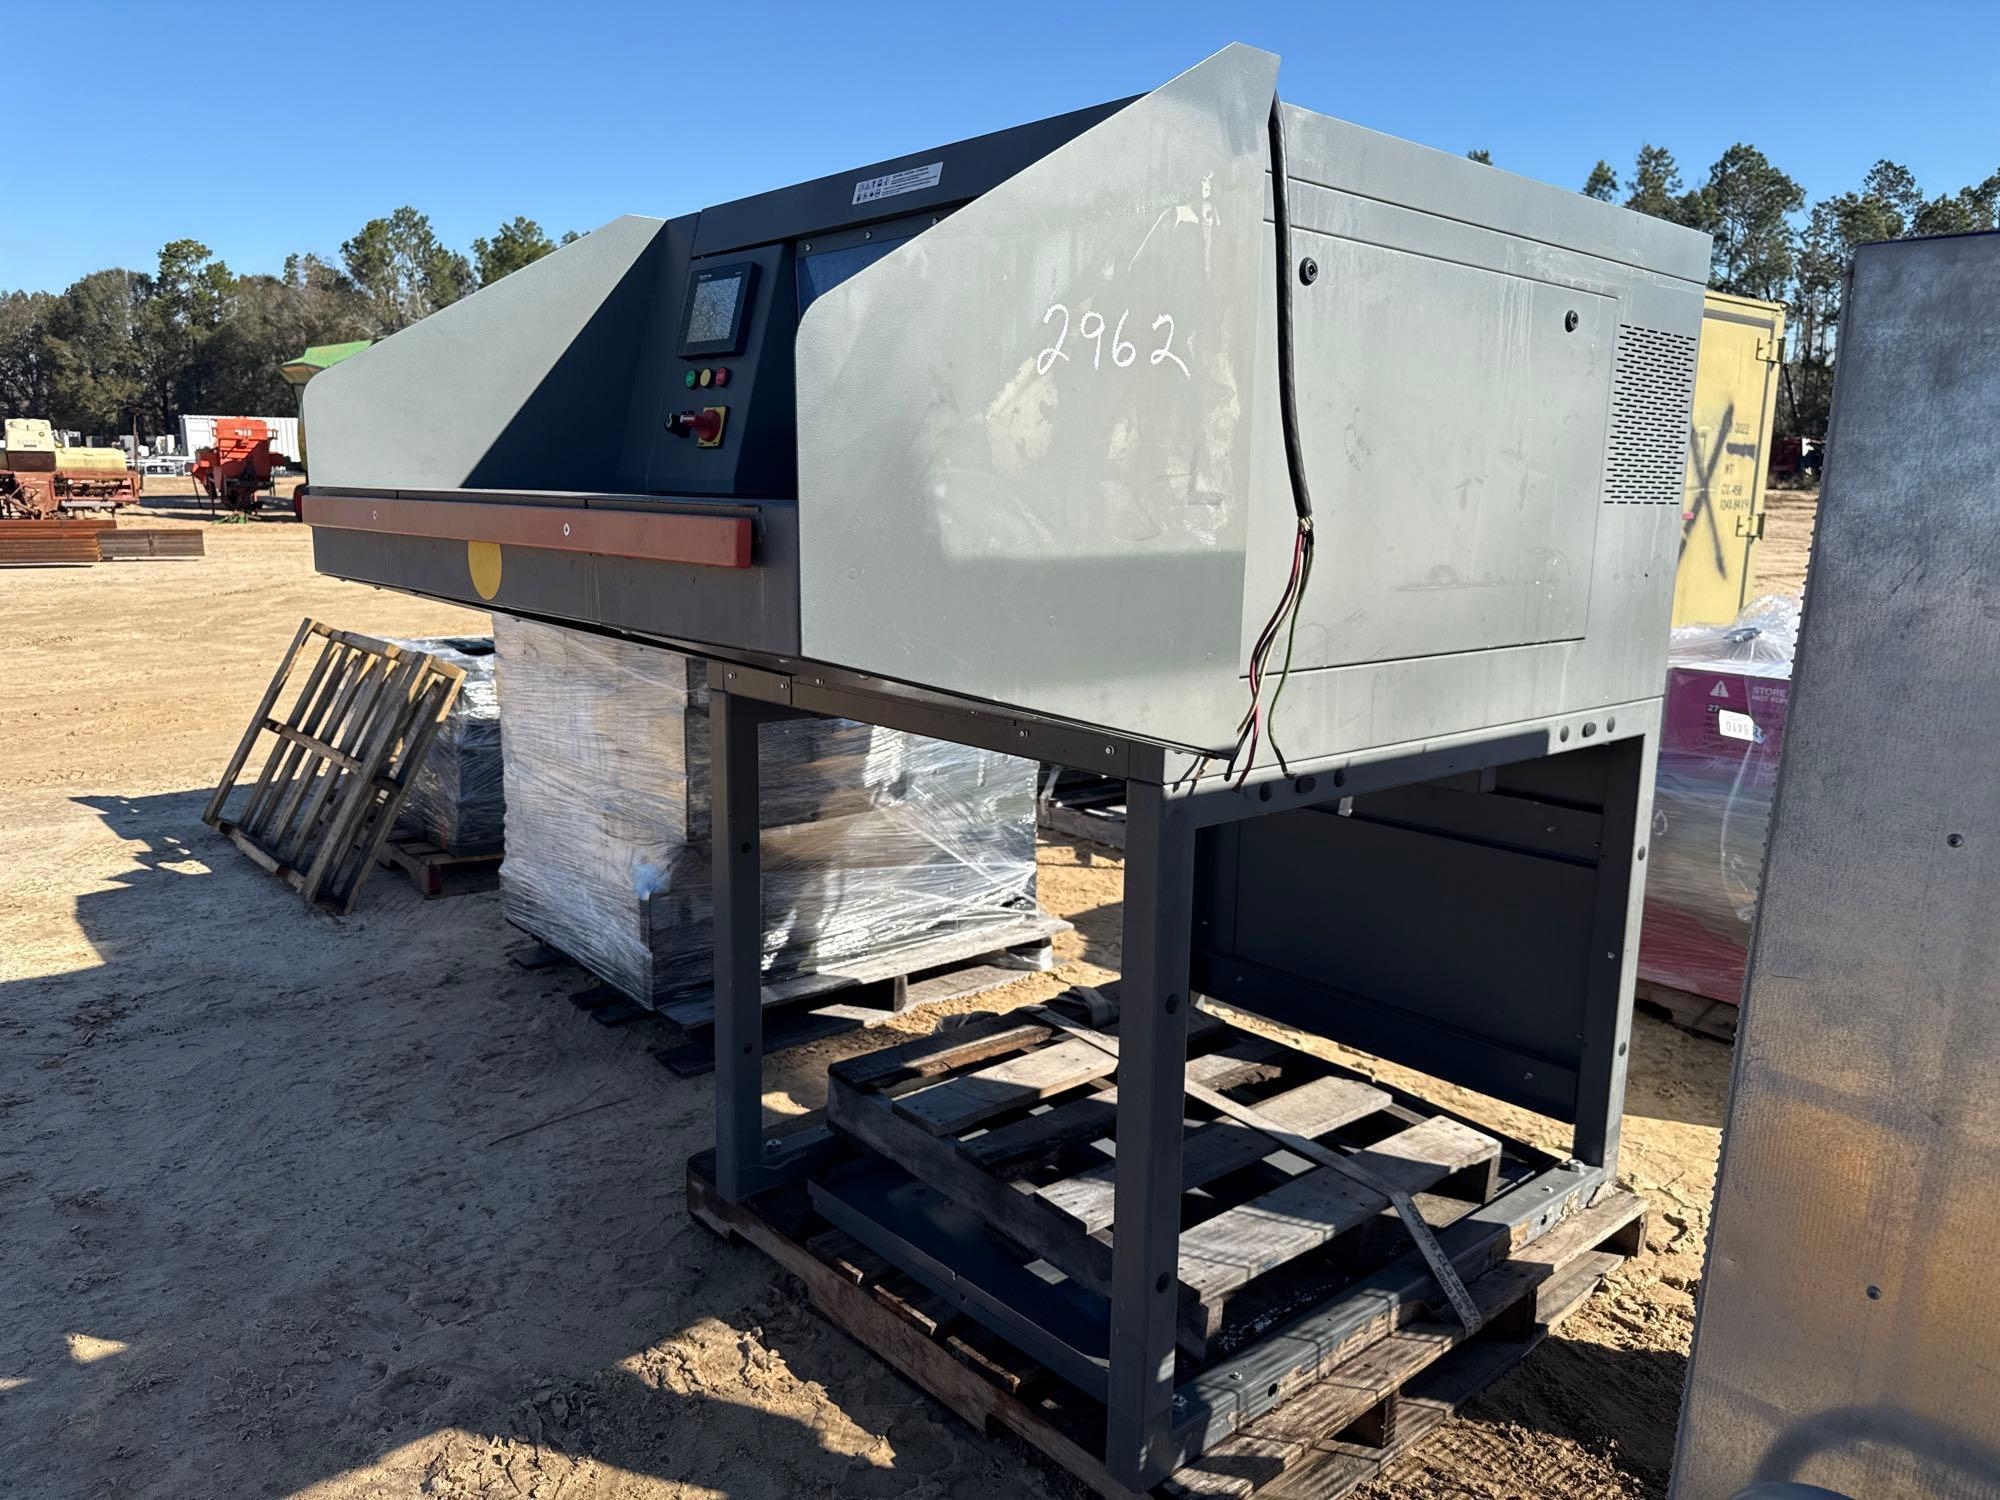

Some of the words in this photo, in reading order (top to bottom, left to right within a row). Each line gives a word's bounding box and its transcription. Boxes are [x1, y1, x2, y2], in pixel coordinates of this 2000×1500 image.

[1036, 303, 1191, 378] 2962
[1751, 686, 1787, 698] STORE
[1751, 694, 1769, 702] NOT
